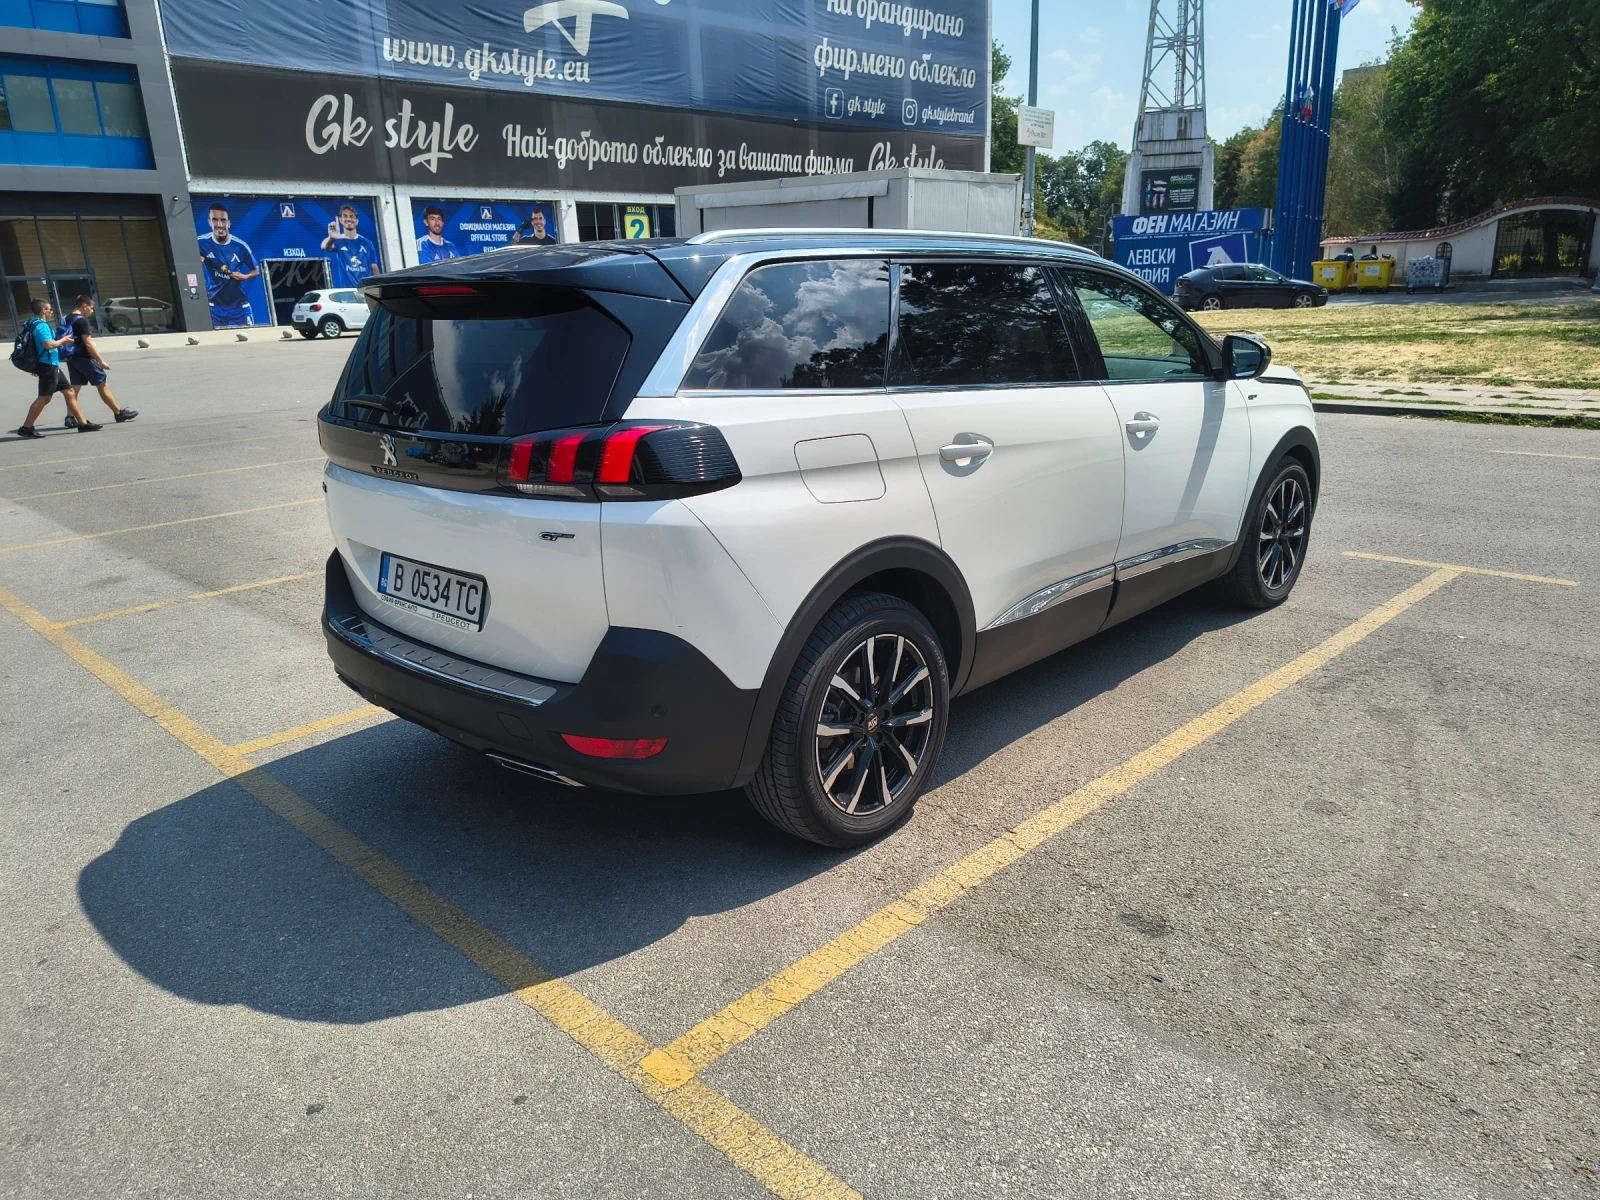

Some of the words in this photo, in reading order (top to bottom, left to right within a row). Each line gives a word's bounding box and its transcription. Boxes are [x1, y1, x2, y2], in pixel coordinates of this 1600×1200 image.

[383, 37, 590, 87] www.gkstyle.eu
[814, 38, 905, 81] фирмено
[909, 53, 976, 89] облекло
[847, 96, 861, 117] gk
[863, 98, 886, 119] style
[921, 106, 975, 126] gkstylebrand
[306, 93, 373, 155] Gk
[384, 98, 479, 174] style
[502, 124, 638, 171] Най-доброто
[642, 135, 713, 169] облекло
[717, 148, 736, 178] за
[738, 142, 802, 174] вашата
[804, 149, 854, 177] фирма
[627, 206, 645, 214] ВХОД
[459, 222, 492, 232] ОФИЦИАЛЕН
[492, 222, 516, 232] МАГАЗИН
[630, 218, 645, 239] 2
[1132, 215, 1169, 235] ФЕН
[1168, 210, 1241, 232] МАГАЗИН
[470, 233, 492, 242] OFFICIAL
[492, 233, 508, 242] STORE
[283, 248, 307, 258] ИЗХОД
[1127, 247, 1176, 265] ЛЕВСКИ
[1129, 267, 1170, 283] ОФИЯ
[376, 466, 419, 480] PEUGEOT
[393, 563, 405, 592] B
[435, 613, 471, 629] PEUGEOT
